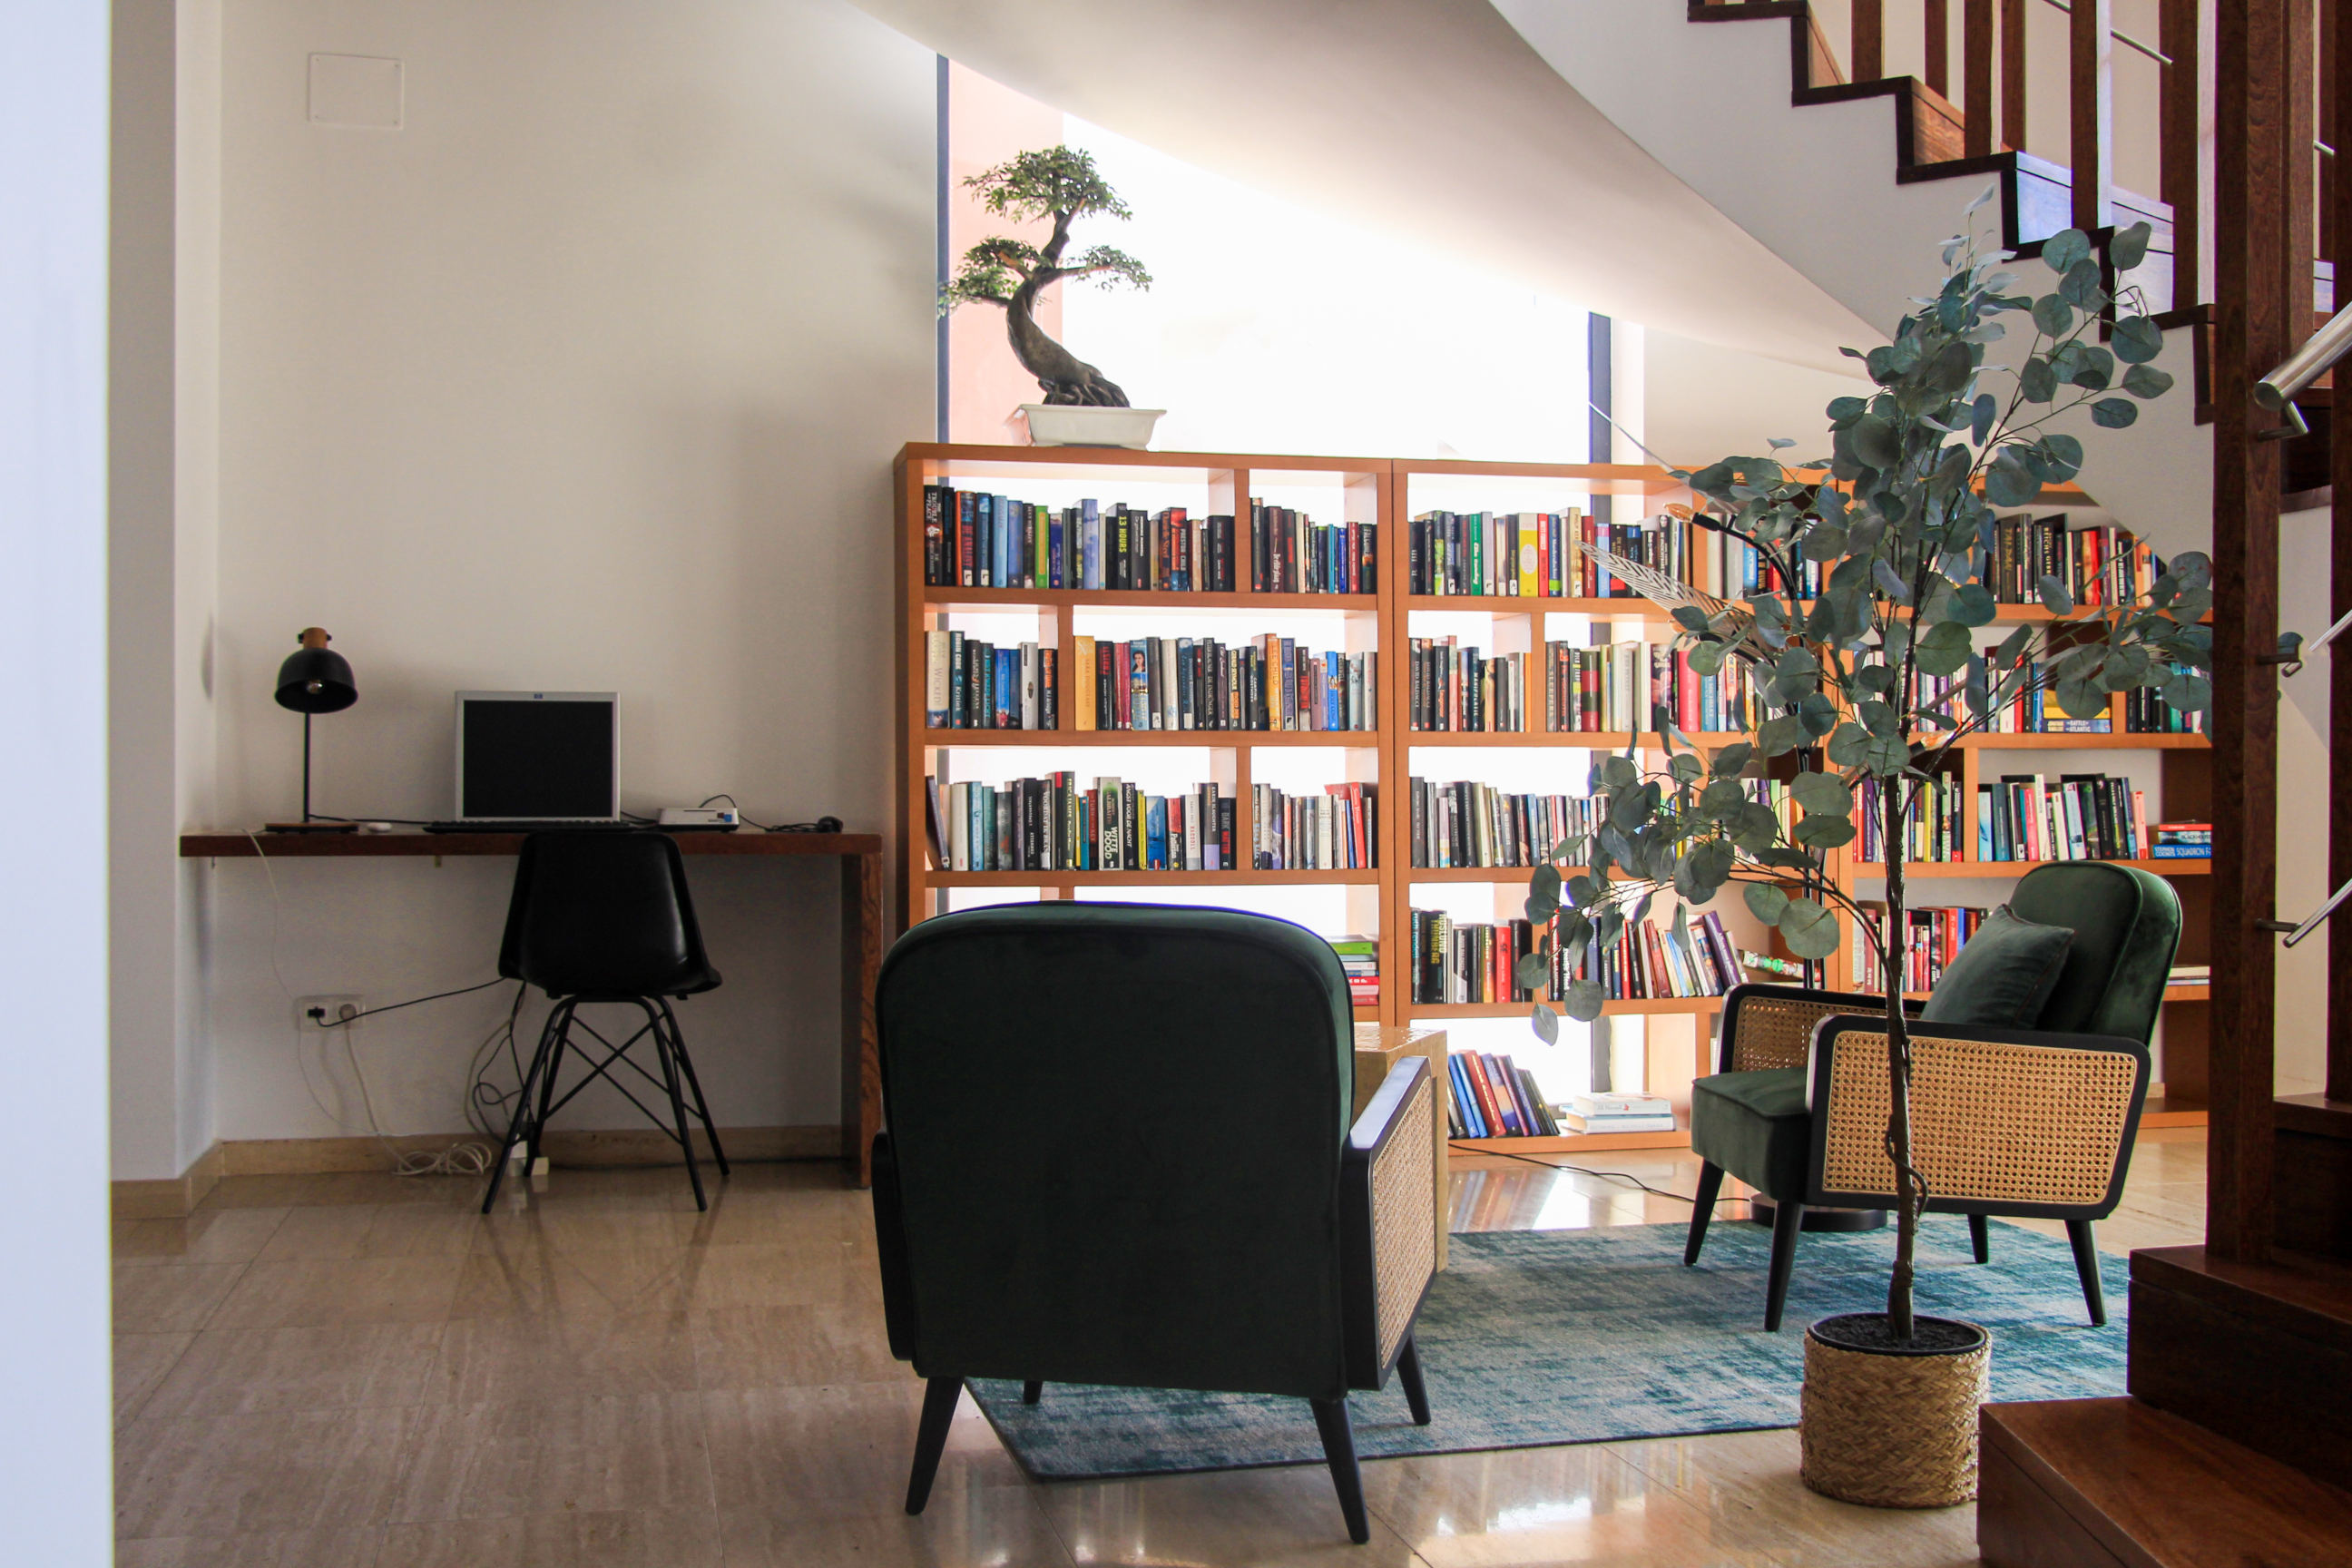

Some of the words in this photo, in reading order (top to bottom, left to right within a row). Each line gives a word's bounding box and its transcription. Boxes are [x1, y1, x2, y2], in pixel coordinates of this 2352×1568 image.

[1119, 516, 1127, 525] 13
[1119, 528, 1127, 553] HOURS
[933, 668, 944, 704] WICKED
[1221, 812, 1230, 829] DARK
[1104, 831, 1112, 859] DOOD
[1170, 833, 1178, 858] Patterson
[1431, 919, 1439, 964] THUNBERG
[1439, 913, 1447, 954] ROSLUND
